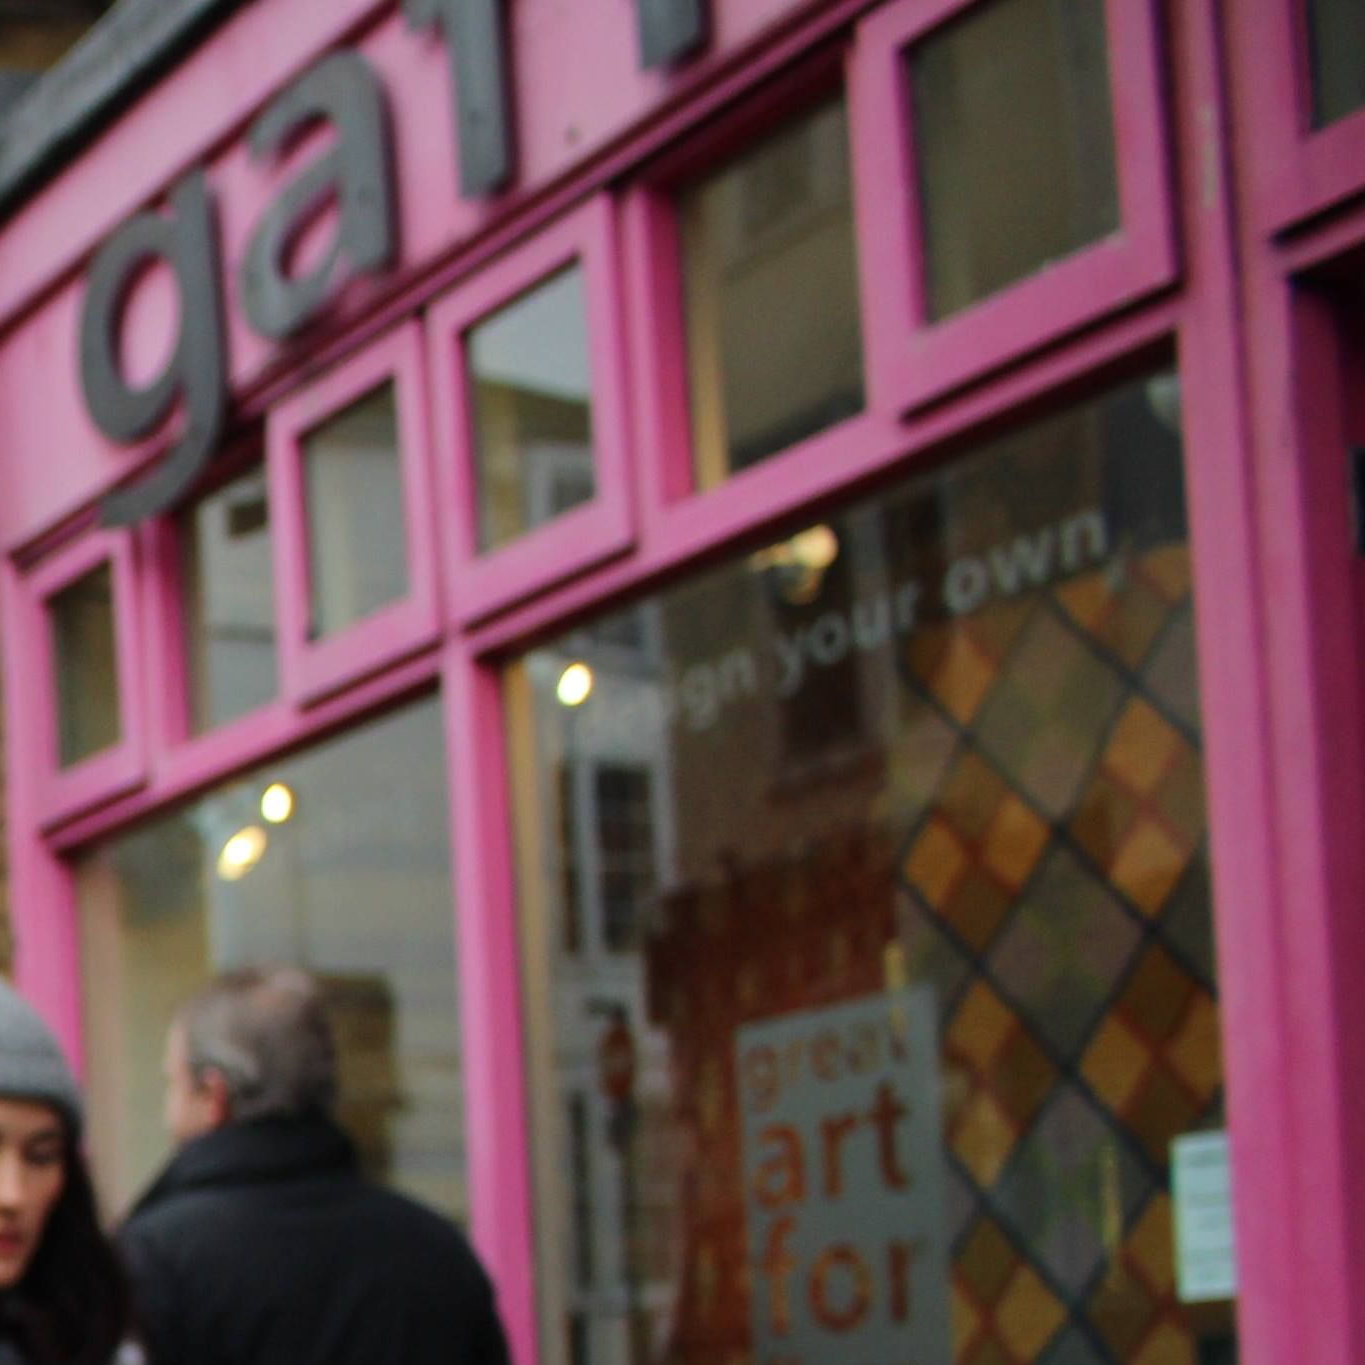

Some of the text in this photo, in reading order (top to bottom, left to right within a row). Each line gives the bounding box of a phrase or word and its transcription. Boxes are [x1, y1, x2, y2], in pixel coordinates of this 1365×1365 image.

[772, 580, 921, 699] your
[753, 1081, 910, 1209] art
[760, 1216, 926, 1338] for
